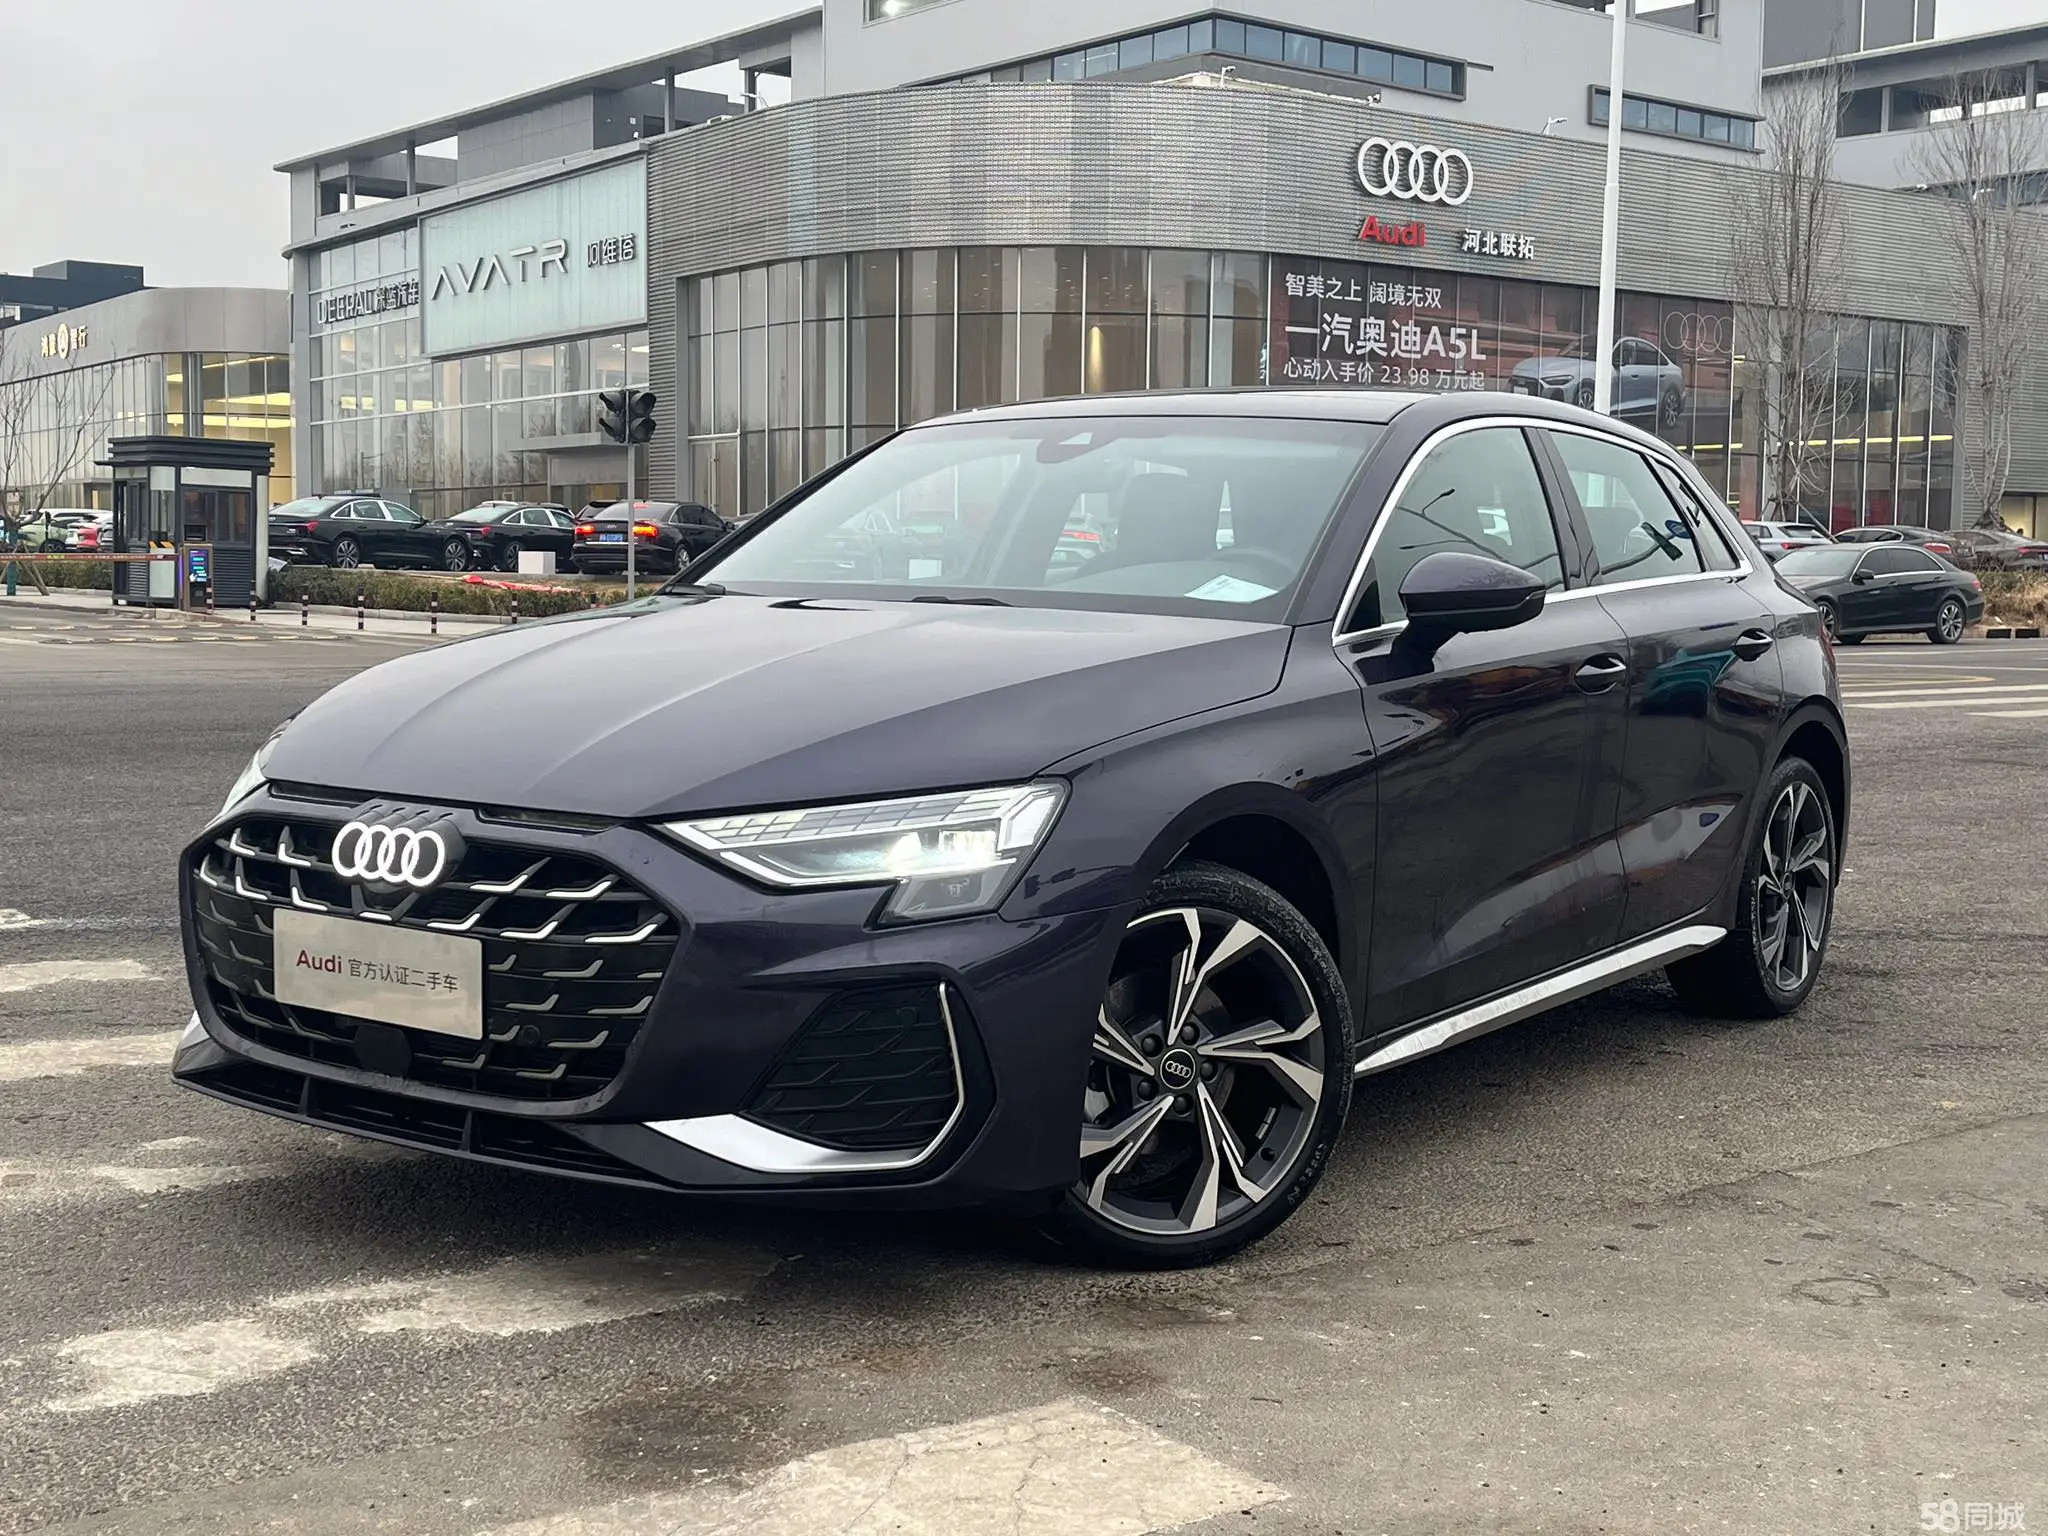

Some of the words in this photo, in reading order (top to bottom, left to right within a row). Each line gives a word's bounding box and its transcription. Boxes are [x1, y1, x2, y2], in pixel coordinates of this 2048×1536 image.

[1358, 215, 1428, 247] Audi
[1461, 228, 1535, 260] 河北联拓
[431, 238, 568, 300] AVATR
[1285, 272, 1362, 302] 智美之上
[1369, 280, 1442, 309] 阔境无双
[1285, 312, 1487, 361] 一汽奥迪A5L
[1283, 356, 1375, 385] 心动入手价
[1380, 365, 1430, 386] 23.98
[1435, 367, 1485, 391] 万元起
[296, 949, 342, 974] Audi
[347, 958, 459, 994] 官方认证二手车
